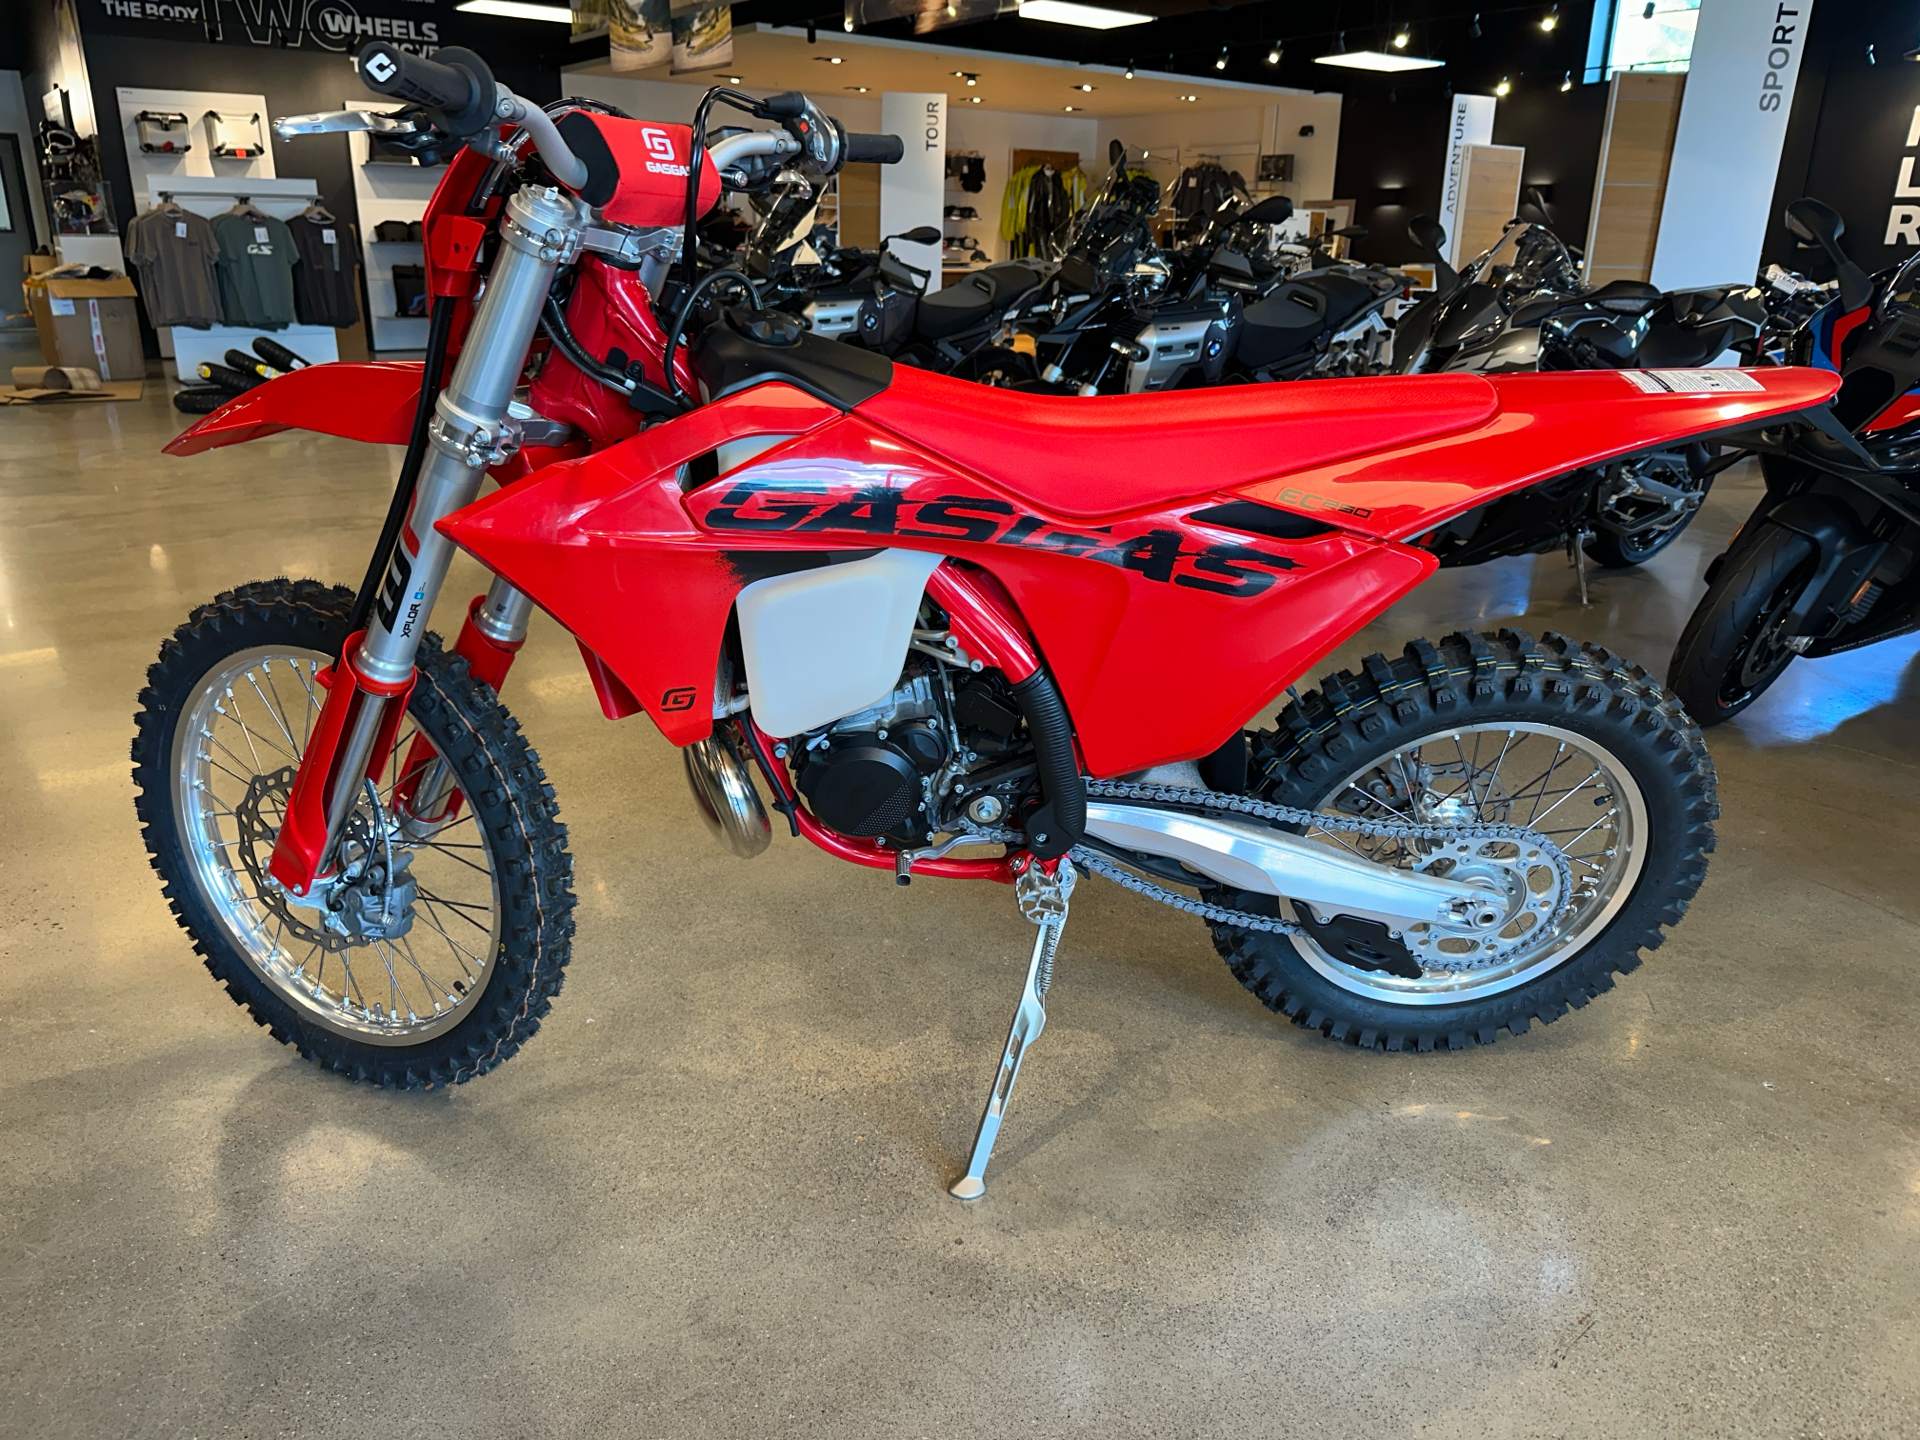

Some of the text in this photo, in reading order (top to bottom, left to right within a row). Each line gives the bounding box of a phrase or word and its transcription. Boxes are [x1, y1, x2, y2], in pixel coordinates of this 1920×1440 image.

[102, 1, 199, 23] THE BODY
[324, 13, 439, 42] WHEELS
[1759, 2, 1799, 112] SPORT
[926, 101, 940, 152] TOUR
[1446, 103, 1467, 214] ADVENTURE
[246, 243, 274, 255] GS
[704, 481, 1308, 598] GASGAS
[400, 602, 422, 638] XPLOR
